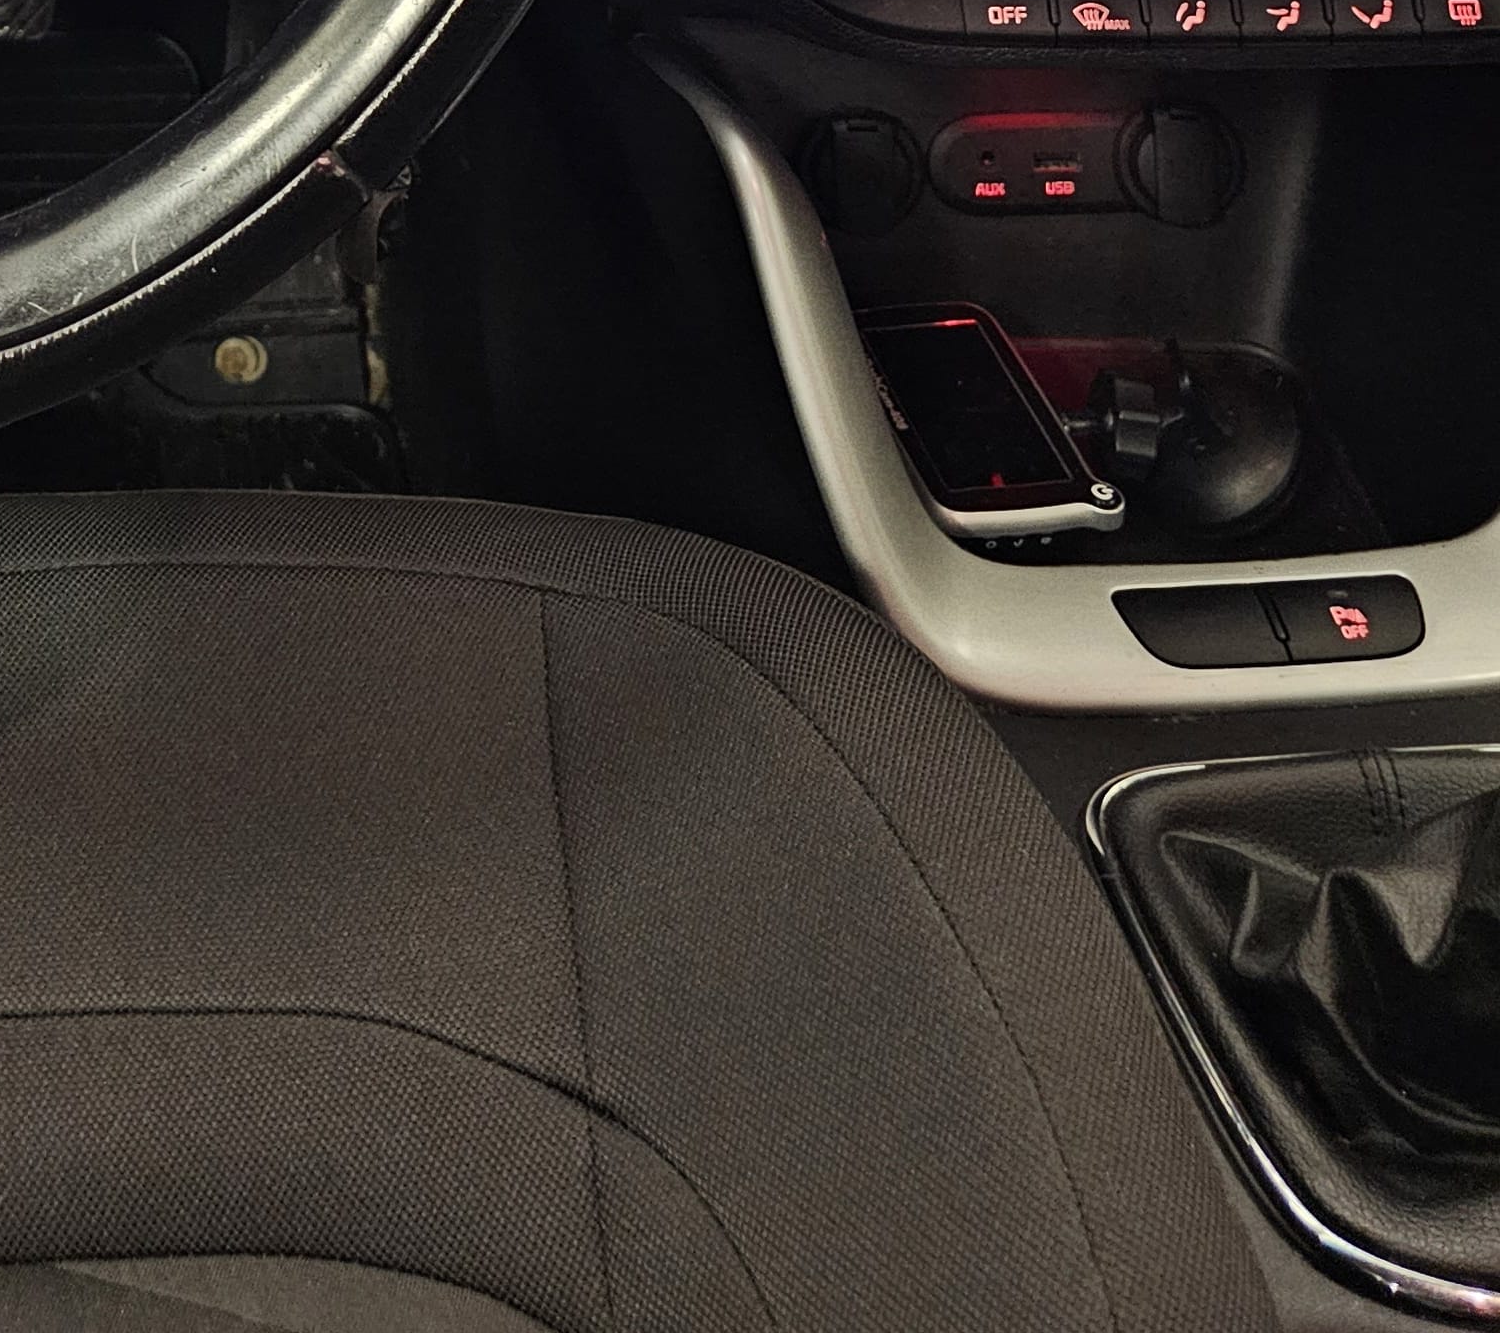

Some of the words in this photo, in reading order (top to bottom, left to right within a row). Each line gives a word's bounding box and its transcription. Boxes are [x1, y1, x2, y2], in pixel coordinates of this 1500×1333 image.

[987, 5, 1029, 25] OFF
[1104, 19, 1131, 31] MAX
[975, 182, 1006, 197] AUX
[1045, 180, 1076, 195] USB
[1340, 624, 1369, 639] OFF
